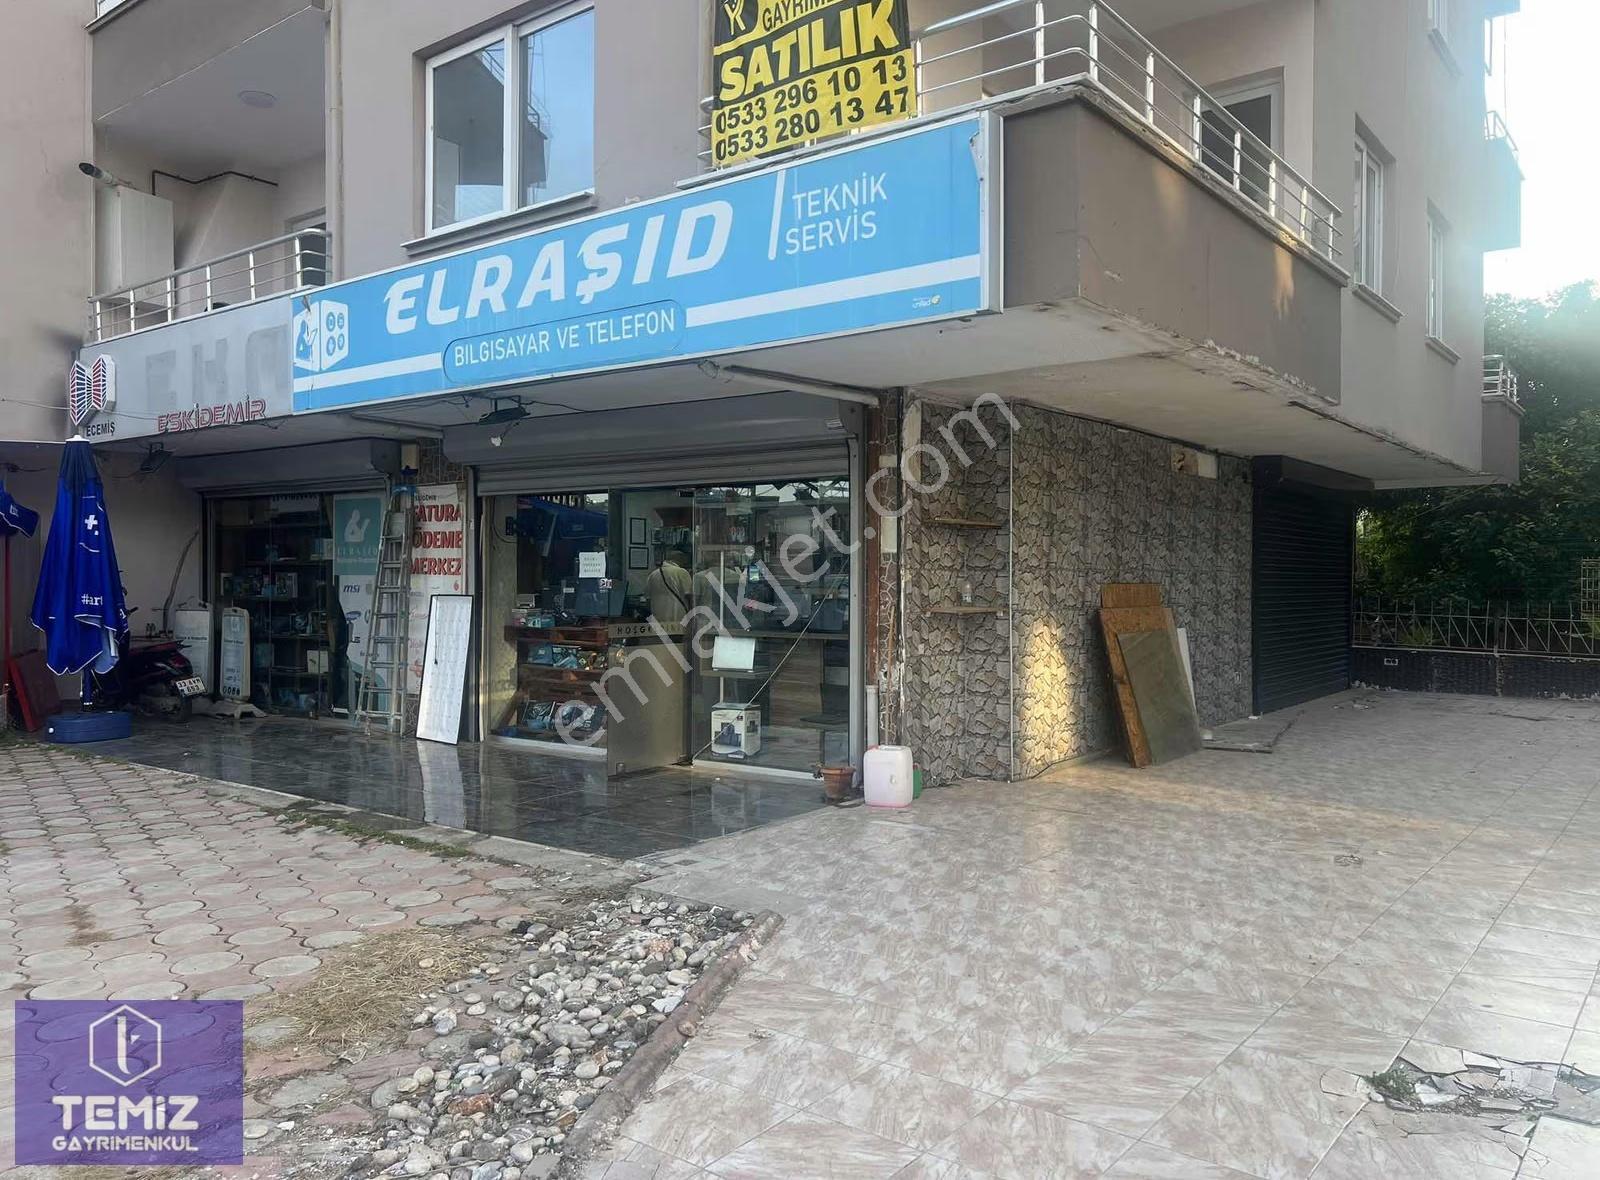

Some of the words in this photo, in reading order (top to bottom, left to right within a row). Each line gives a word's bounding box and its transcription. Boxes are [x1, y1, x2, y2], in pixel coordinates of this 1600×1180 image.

[719, 0, 900, 101] SATILIK
[715, 97, 767, 134] 0533
[773, 79, 818, 115] 296
[827, 67, 861, 97] 10
[872, 55, 907, 85] 13
[715, 126, 768, 160] 0533
[775, 109, 820, 143] 280
[830, 97, 865, 126] 13
[875, 86, 909, 116] 47
[792, 172, 887, 219] TEKNİK
[785, 208, 877, 255] SERVİS
[383, 200, 734, 335] ELRAŞID
[454, 330, 550, 367] BILGISAYAR
[557, 325, 580, 350] VE
[586, 307, 675, 345] TELEFON
[157, 394, 267, 433] ESKİDEMİR
